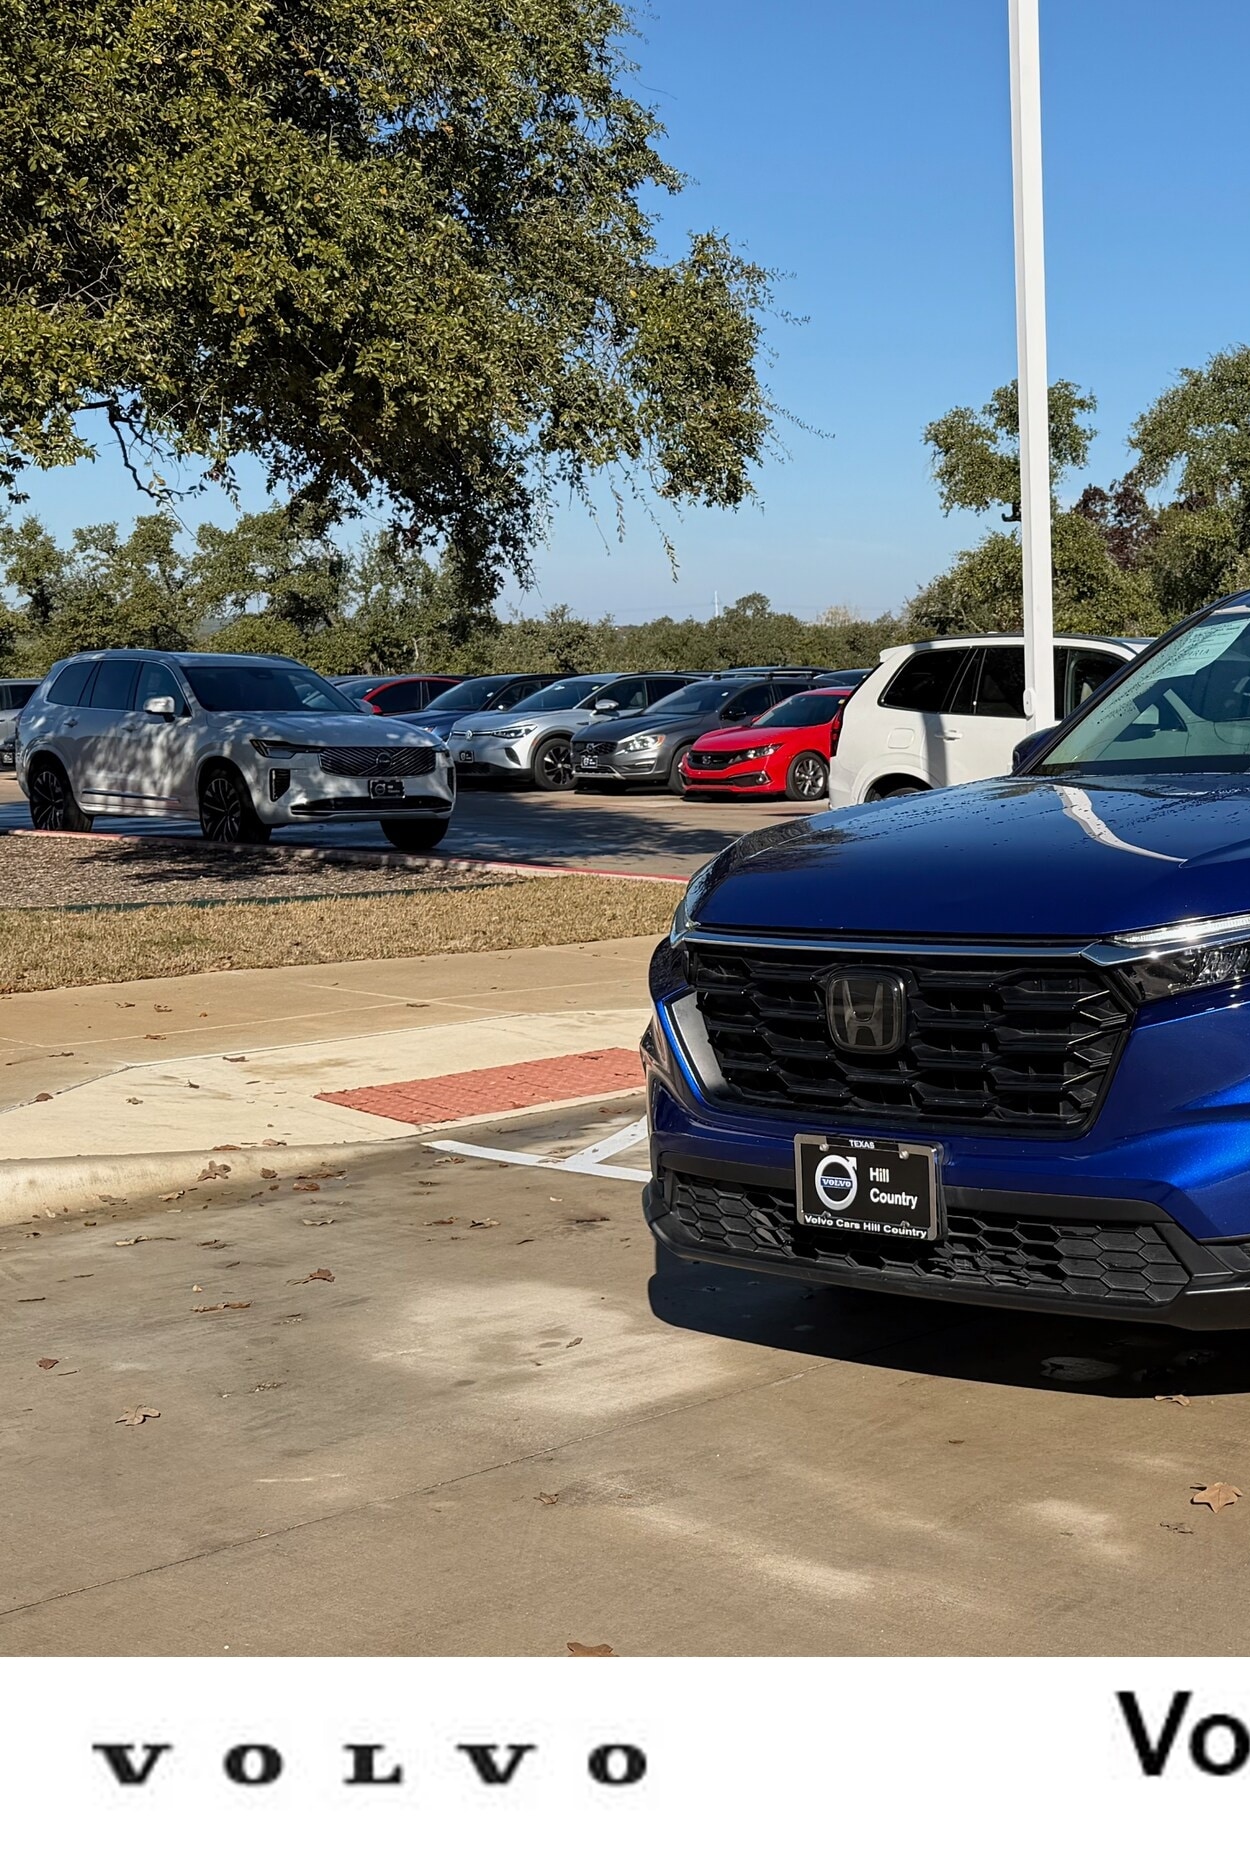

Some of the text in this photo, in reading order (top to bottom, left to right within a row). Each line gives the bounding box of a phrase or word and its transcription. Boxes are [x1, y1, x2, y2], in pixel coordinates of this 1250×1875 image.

[849, 1139, 875, 1149] TEXAS
[822, 1178, 852, 1188] VOLVO
[869, 1167, 890, 1183] Hill
[869, 1187, 918, 1210] Country
[804, 1214, 927, 1239] Volvo Cars Hill Country
